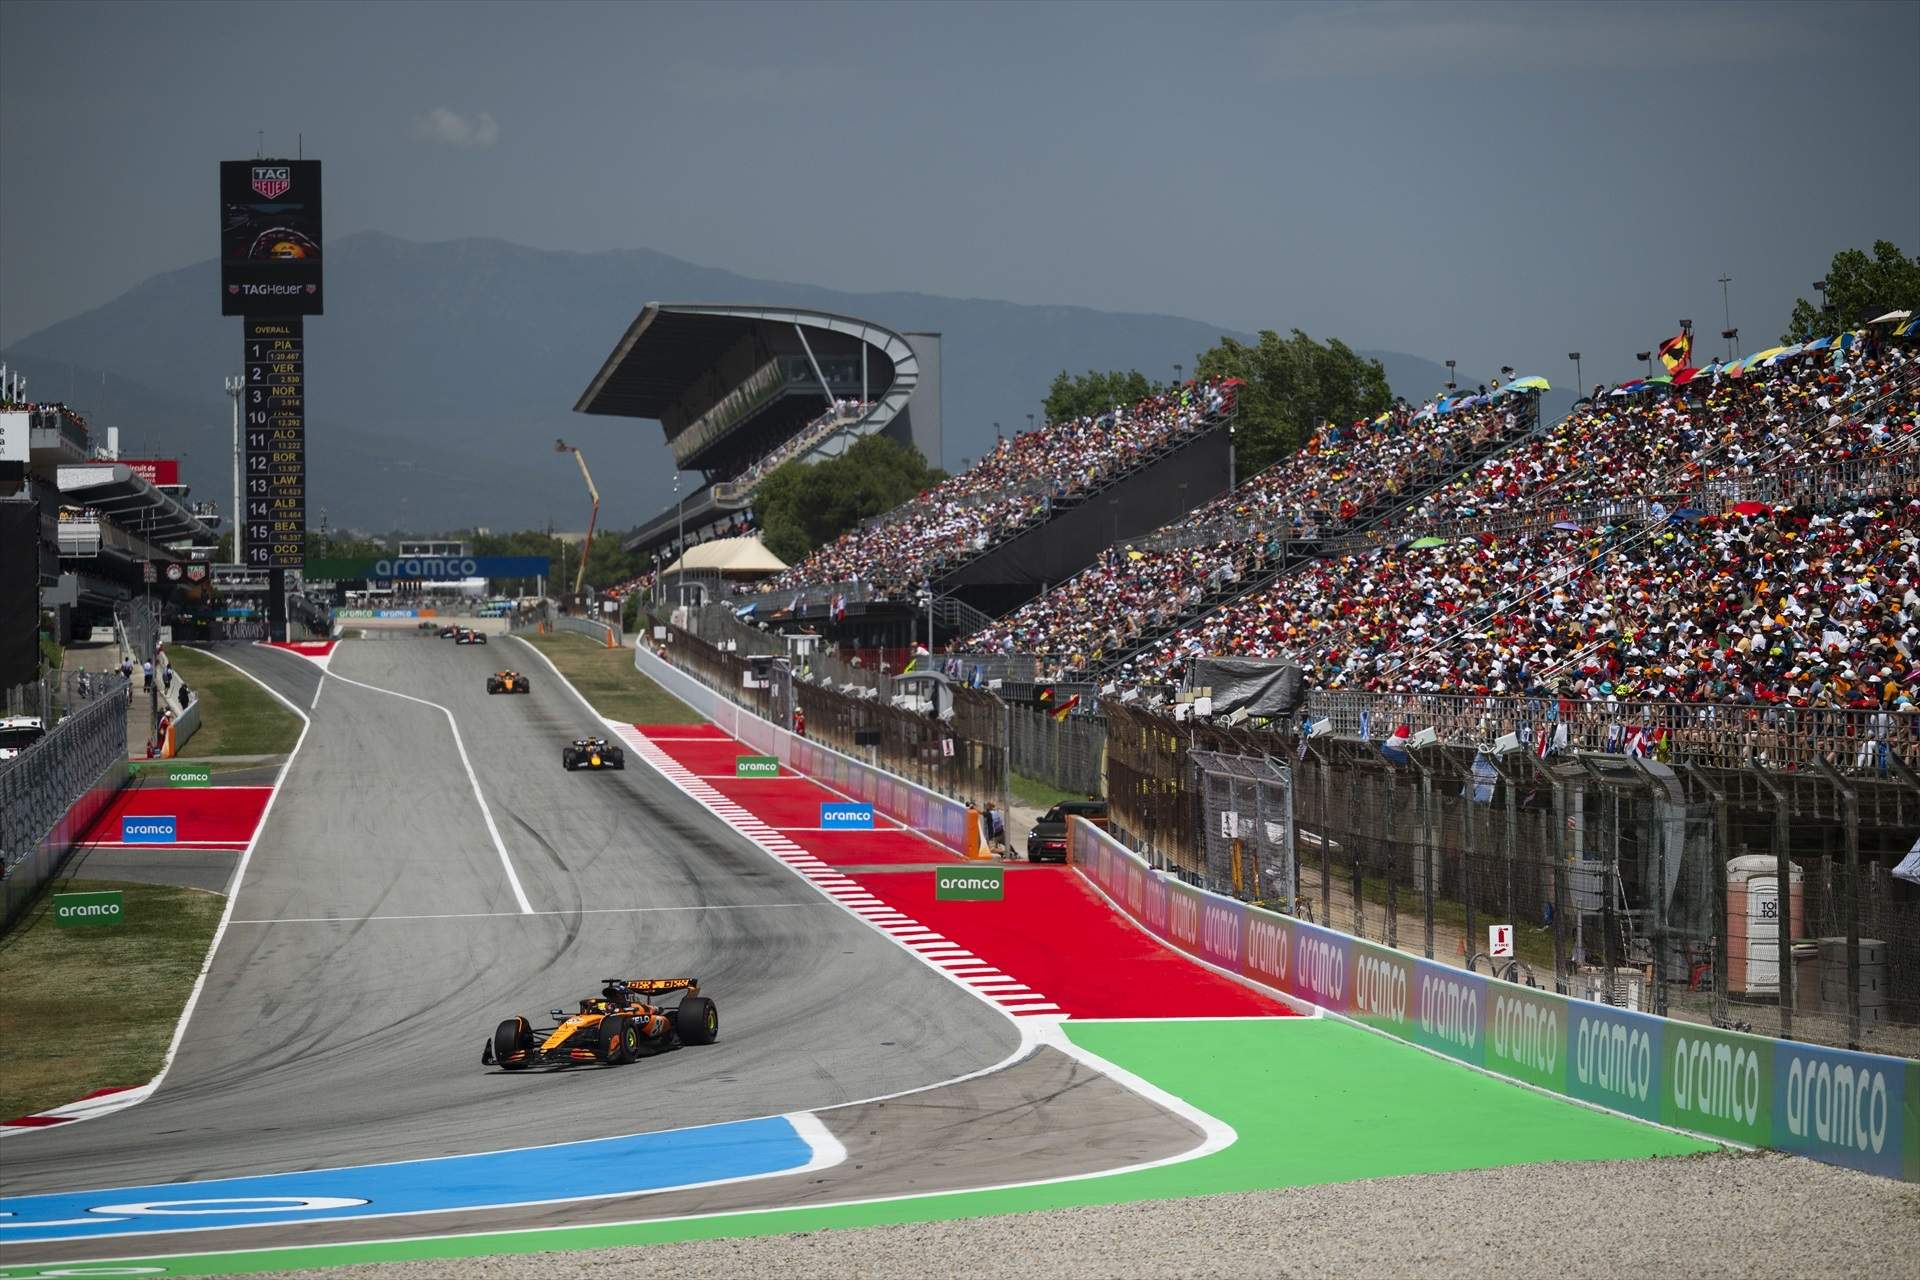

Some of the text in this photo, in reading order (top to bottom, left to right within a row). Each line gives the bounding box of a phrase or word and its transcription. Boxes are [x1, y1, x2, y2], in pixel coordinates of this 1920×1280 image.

[256, 169, 287, 179] TAG
[254, 180, 288, 197] HEUER
[255, 326, 290, 334] OVERALL
[252, 341, 292, 358] 1 PIA
[252, 364, 295, 380] 2 VER
[253, 386, 295, 403] 3 NOR
[249, 411, 266, 424] 10
[250, 430, 296, 446] 11 ALO
[250, 453, 296, 470] 12 BOR
[250, 476, 297, 492] 13 LAW
[250, 499, 296, 516] 14 ALB
[250, 522, 297, 538] 15 BEA
[250, 544, 298, 561] 16 OCO
[375, 559, 477, 577] aramco
[339, 610, 373, 618] aramco
[380, 610, 412, 618] aramco
[738, 761, 777, 772] aramco
[170, 772, 208, 782] aramco
[824, 809, 871, 822] aramco
[125, 824, 174, 835] aramco
[940, 877, 1000, 890] aramco
[59, 903, 120, 917] aramco
[1204, 905, 1240, 962] aramco
[1248, 918, 1288, 982] aramco
[1298, 935, 1344, 1001] aramco
[1356, 954, 1408, 1025] aramco
[1421, 974, 1477, 1049] aramco
[1494, 994, 1557, 1075] aramco
[1577, 1016, 1651, 1102] aramco
[1674, 1037, 1760, 1127] aramco
[1787, 1056, 1888, 1154] aramco
